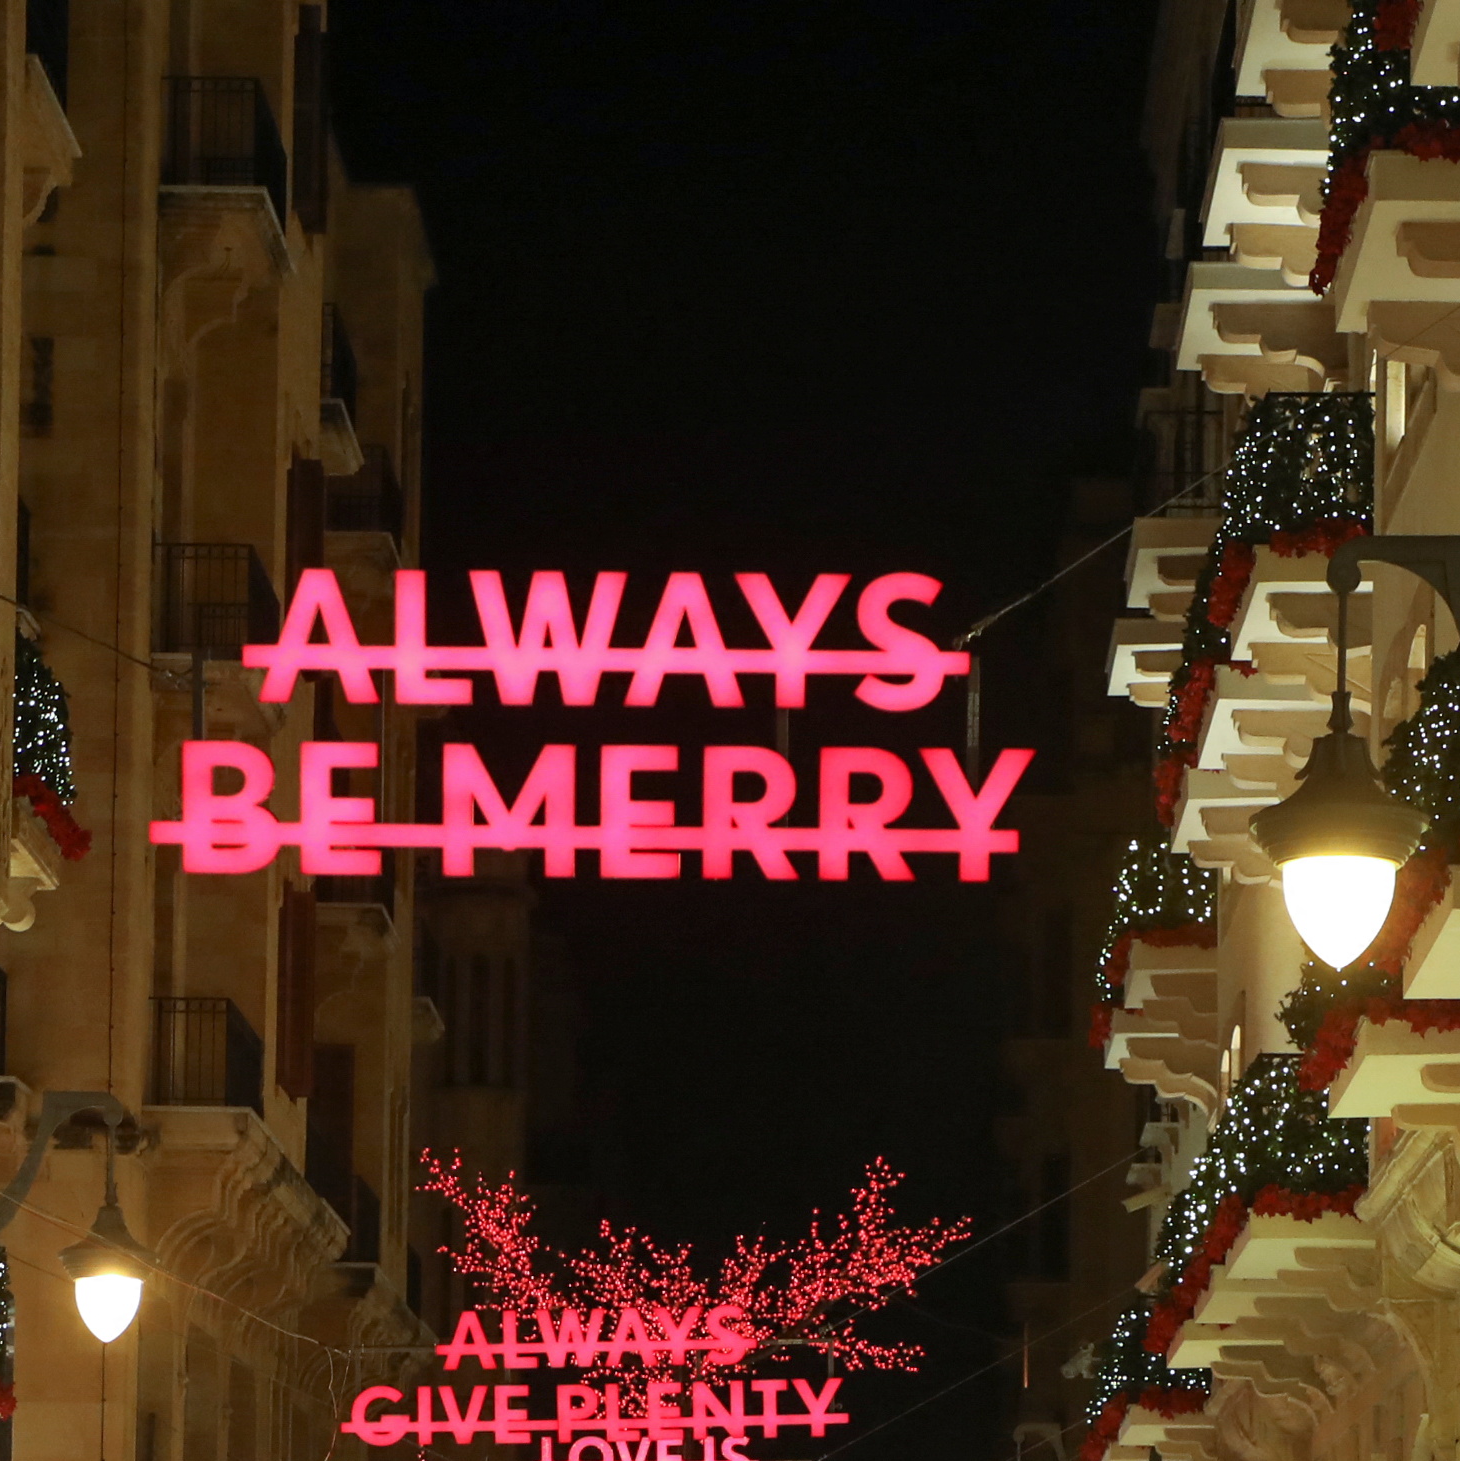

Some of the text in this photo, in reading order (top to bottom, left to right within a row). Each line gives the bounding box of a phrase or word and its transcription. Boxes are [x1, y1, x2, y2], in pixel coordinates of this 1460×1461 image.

[258, 568, 947, 712] ALWAYS
[181, 741, 1037, 882] BE MERRY
[443, 1304, 749, 1371] ALWAYS
[350, 1377, 844, 1447] GIVE PLENTY
